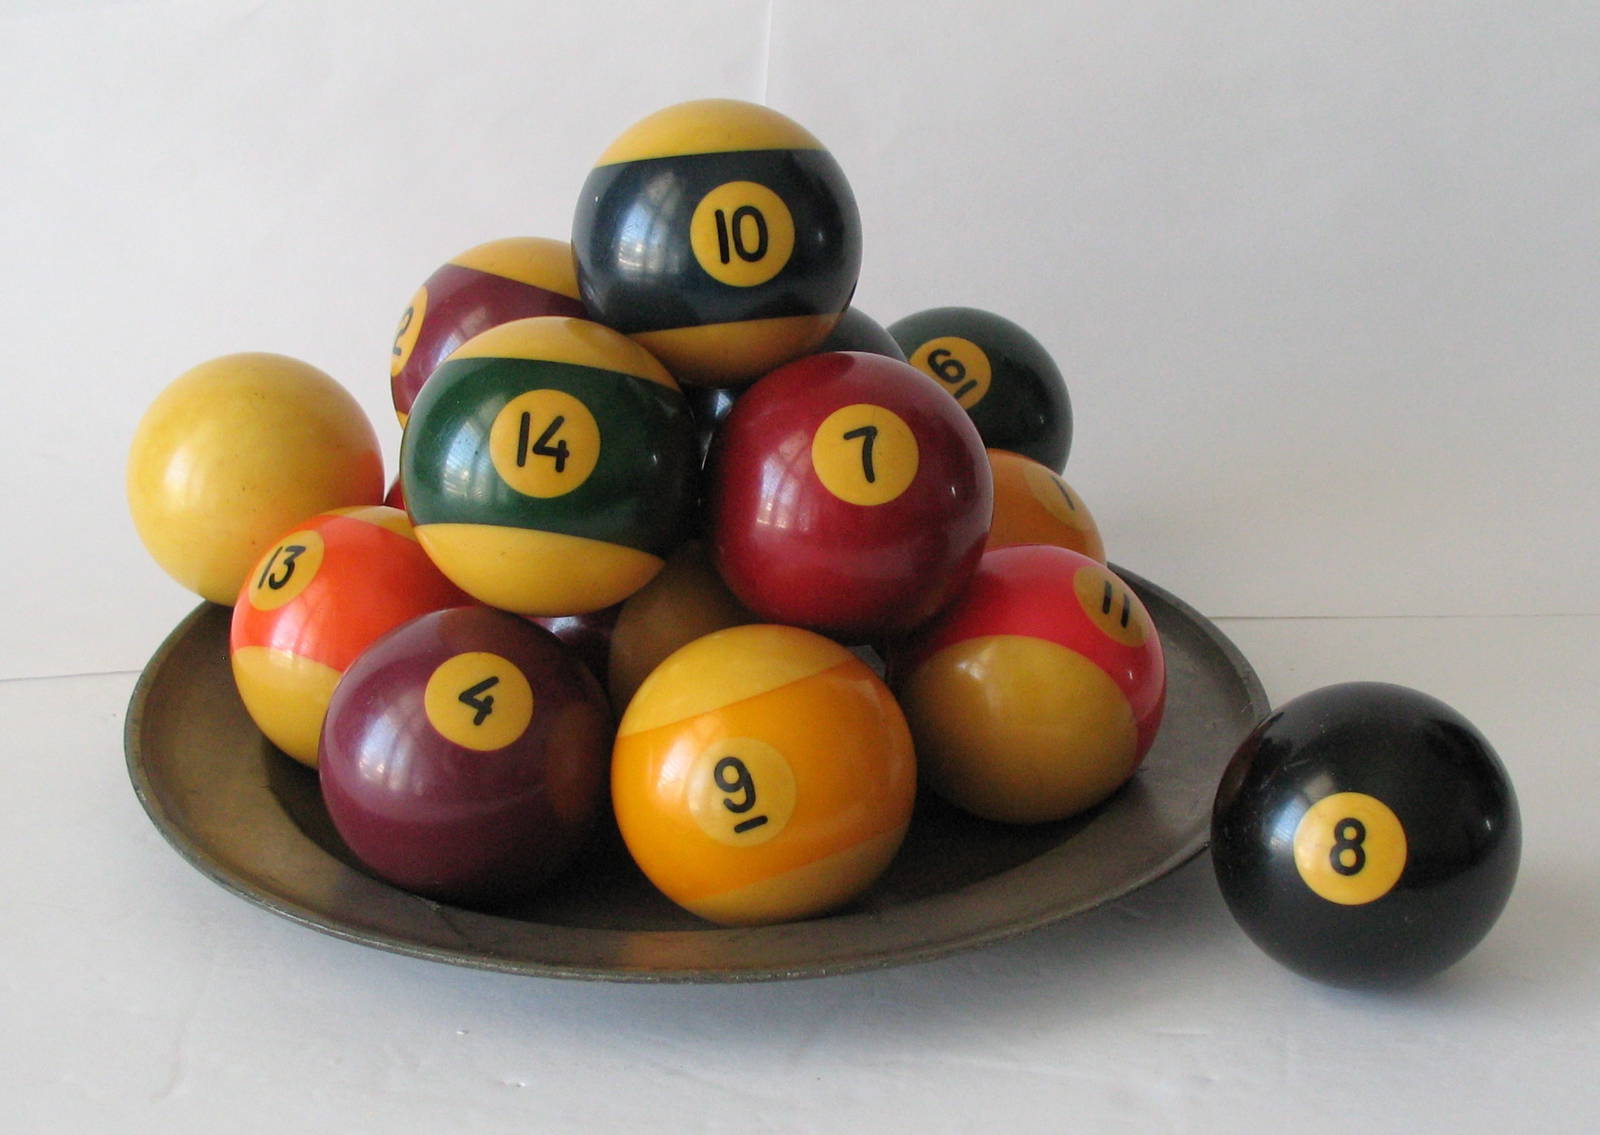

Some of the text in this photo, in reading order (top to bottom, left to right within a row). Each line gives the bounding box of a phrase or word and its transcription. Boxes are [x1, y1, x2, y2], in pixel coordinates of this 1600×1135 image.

[714, 204, 770, 265] 10
[926, 346, 967, 386] 6
[516, 411, 571, 474] 14
[842, 424, 879, 484] 7
[258, 546, 306, 590] 13
[1100, 580, 1129, 628] 11
[457, 675, 500, 727] 4
[712, 755, 759, 816] 9
[1329, 817, 1367, 877] 8
